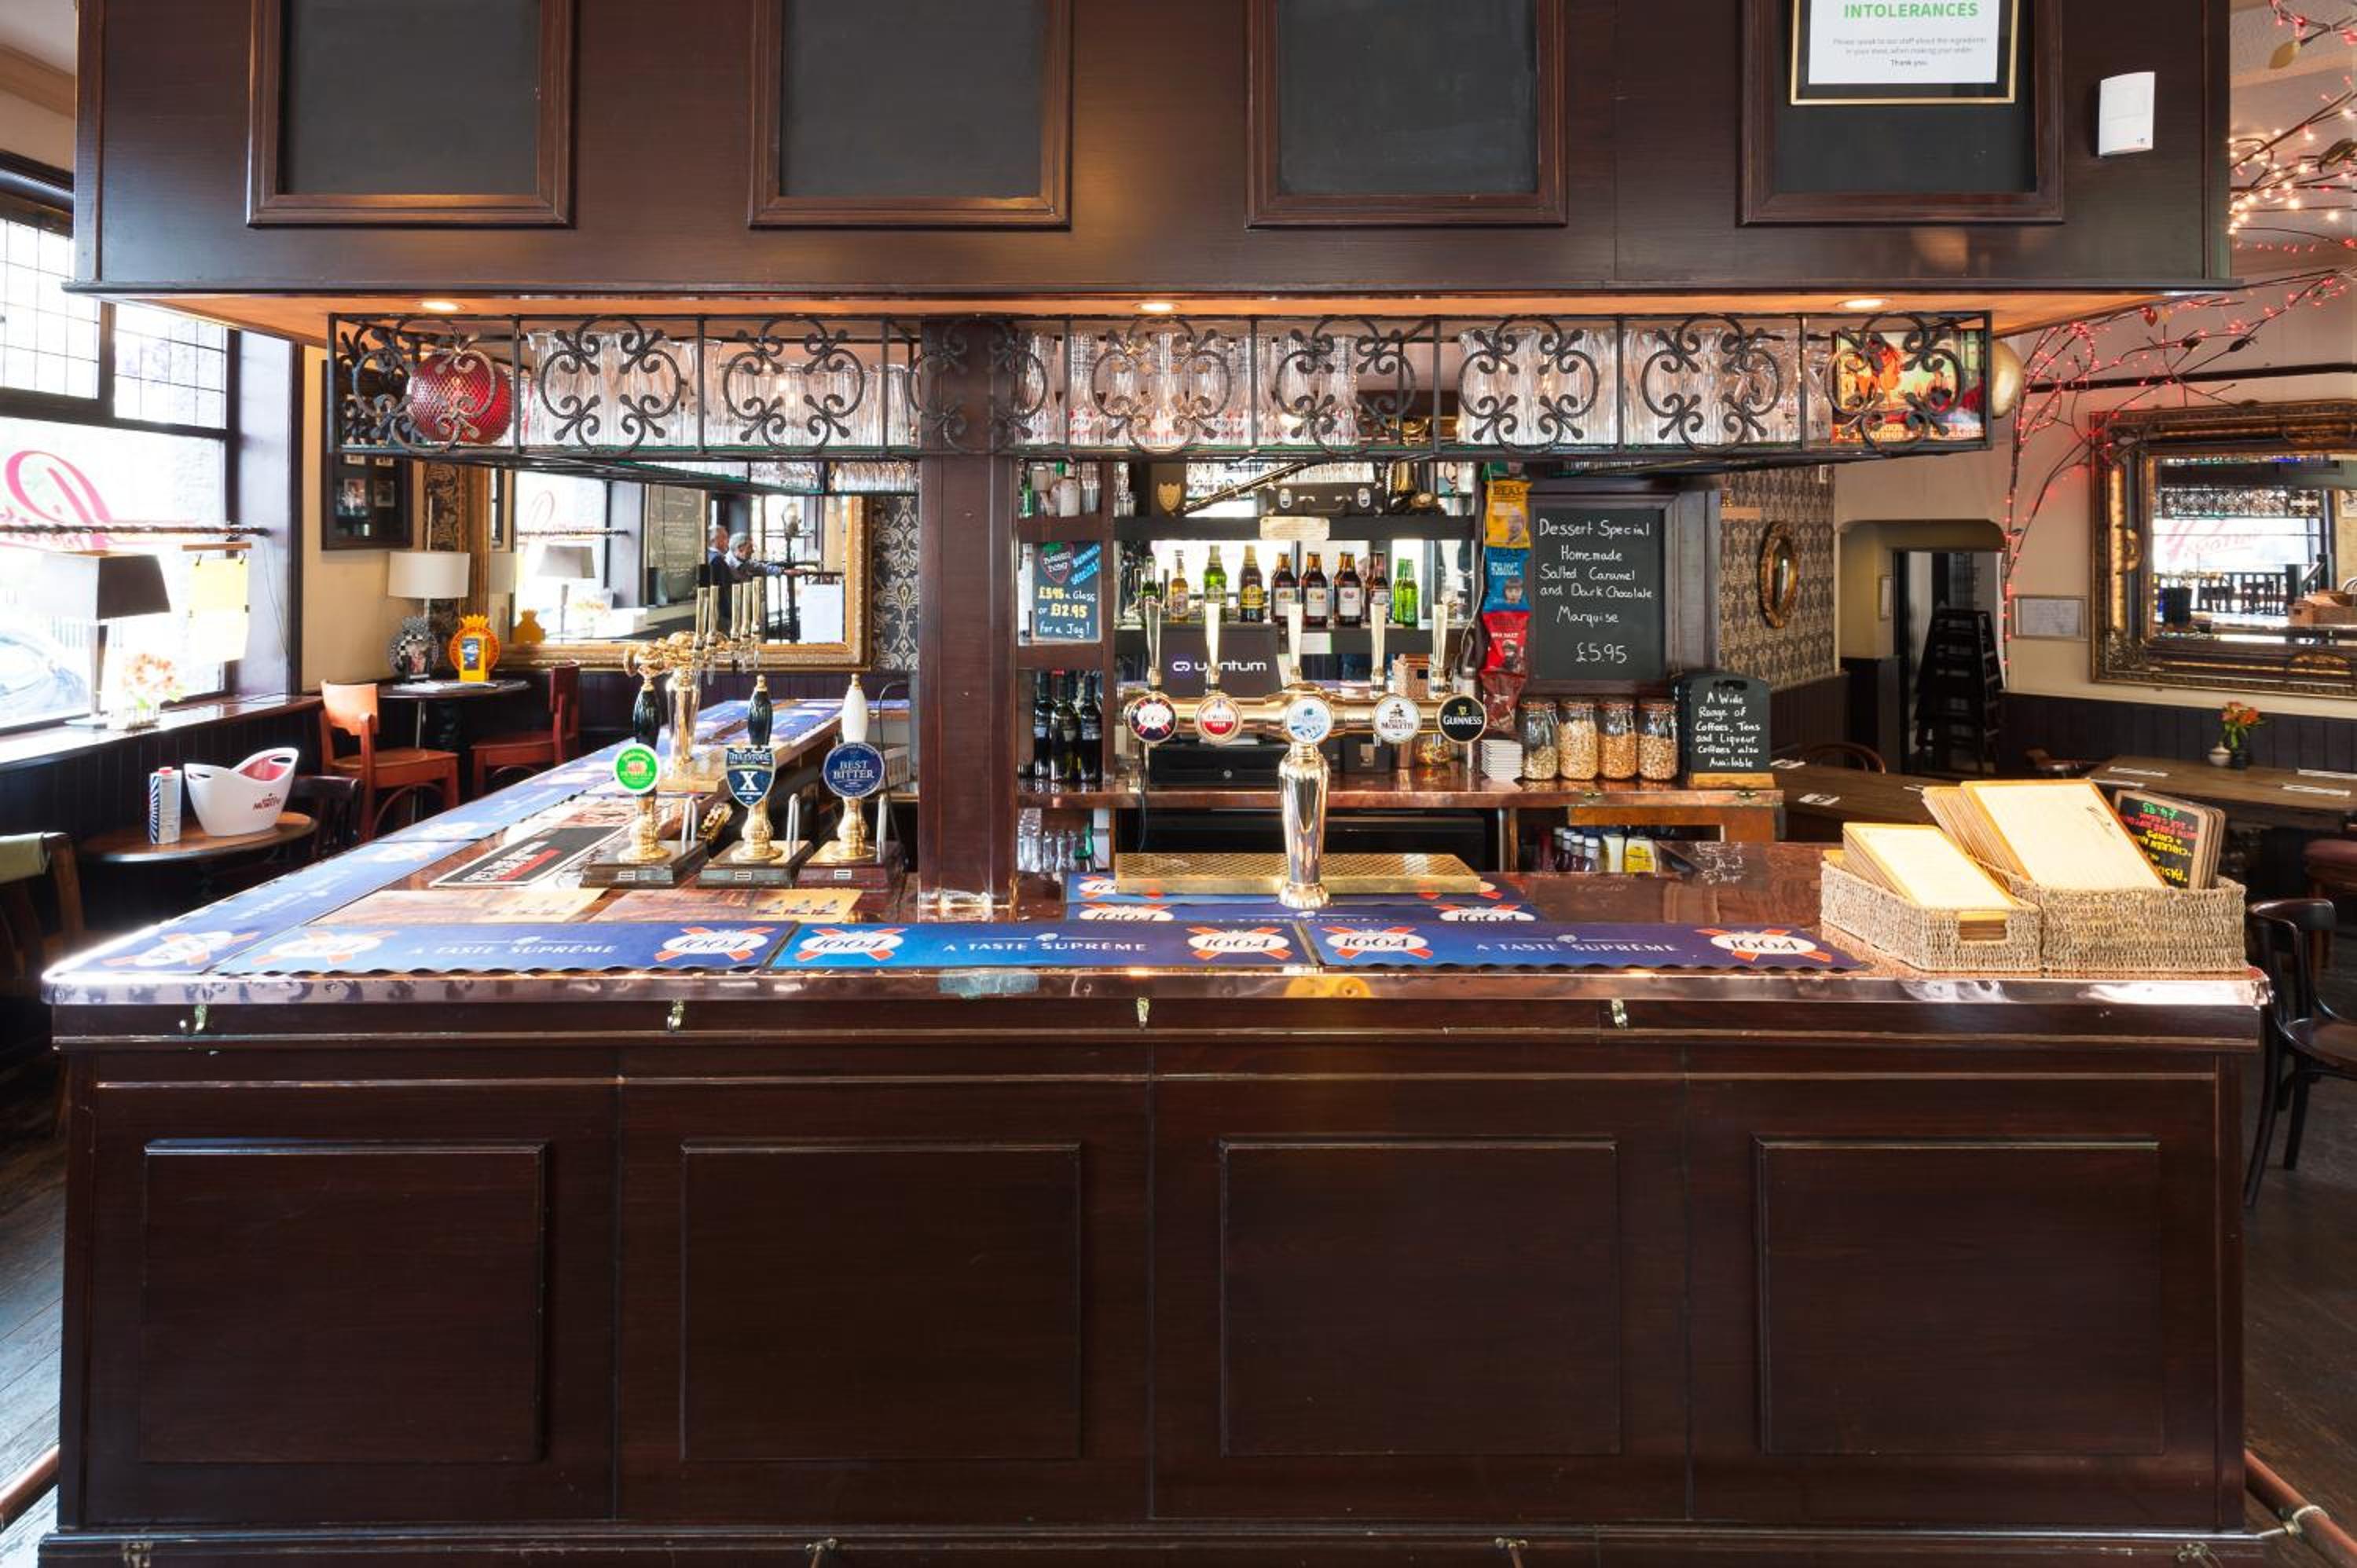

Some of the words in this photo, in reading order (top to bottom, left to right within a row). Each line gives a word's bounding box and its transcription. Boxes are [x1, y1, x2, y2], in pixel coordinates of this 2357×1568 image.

[1844, 2, 1978, 18] INTOLERANCES
[1539, 518, 1593, 537] Dessert
[1598, 519, 1650, 540] Special
[1561, 544, 1622, 562] Homemade
[1540, 563, 1577, 580] Salted
[1589, 566, 1635, 581] Caramel
[1072, 590, 1096, 603] Glass
[1540, 584, 1563, 595] and
[1571, 583, 1603, 597] Dark
[1606, 586, 1653, 599] Chocolate
[1556, 605, 1619, 628] Marquise
[1039, 621, 1054, 633] for
[1575, 642, 1627, 664] £5.95
[1173, 660, 1266, 672] Quntum
[1706, 691, 1714, 703] A
[1718, 693, 1743, 705] Wide
[1698, 706, 1728, 721] Range
[1734, 706, 1747, 717] of
[1442, 715, 1483, 725] GUINNESS
[1736, 720, 1761, 731] Teas
[1695, 733, 1712, 742] and
[1720, 733, 1758, 746] Liqueur
[1698, 745, 1731, 753] Coffees
[1737, 745, 1759, 753] also
[840, 760, 868, 769] BEST
[1710, 757, 1754, 768] Available
[833, 770, 874, 779] BITTER
[739, 771, 760, 791] X
[944, 943, 956, 952] A
[967, 943, 1028, 951] TASTE
[1041, 941, 1147, 952] SUPRÊME
[1204, 937, 1271, 949] 1664
[1343, 937, 1410, 949] 1664
[1475, 943, 1490, 952] A
[1499, 943, 1560, 952] TASTE
[1571, 943, 1678, 953] SUPRÊME
[1730, 939, 1798, 951] 1664
[411, 946, 423, 955] A
[434, 945, 493, 955] TASTE
